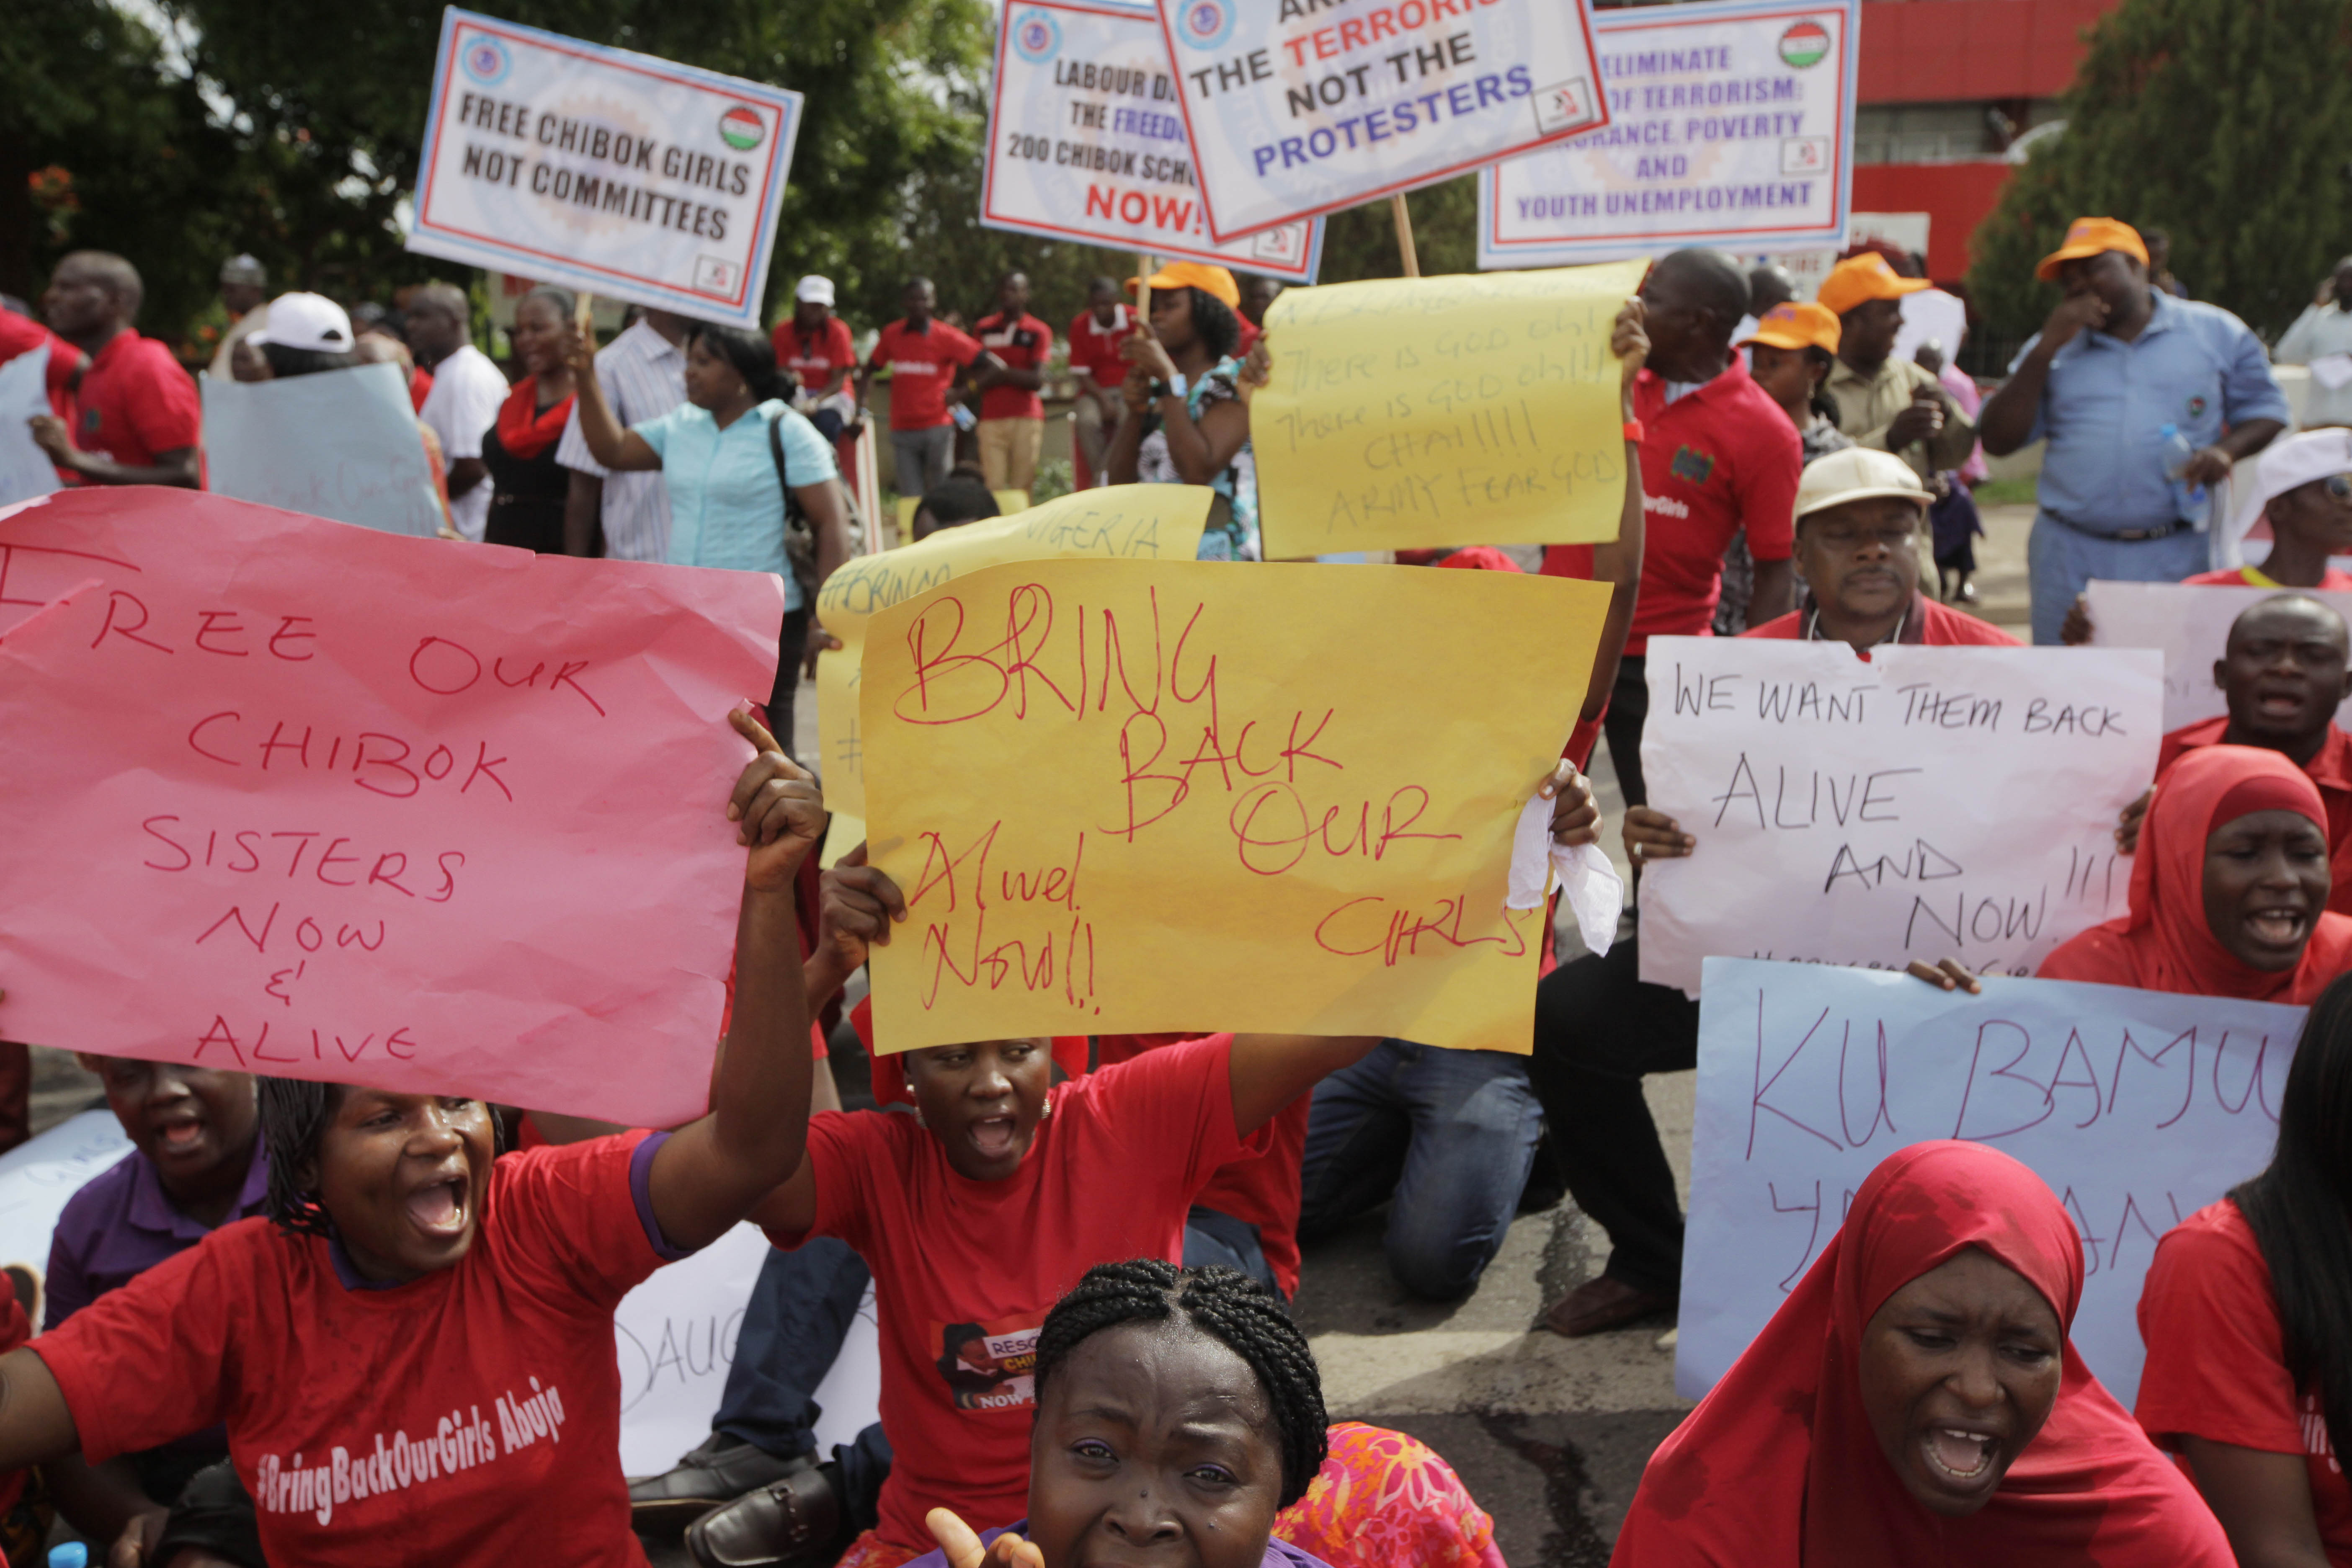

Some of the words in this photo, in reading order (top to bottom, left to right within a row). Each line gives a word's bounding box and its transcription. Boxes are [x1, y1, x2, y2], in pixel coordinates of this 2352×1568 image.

[1055, 59, 1146, 96] LABOUR
[1189, 49, 1274, 99] THE
[1286, 64, 1371, 118] NOT
[1385, 31, 1477, 83] THE
[459, 92, 528, 141] FREE
[537, 112, 657, 170] CHIBOK
[663, 147, 750, 198] GIRLS
[1071, 101, 1107, 129] THE
[1252, 64, 1533, 178] PROTESTERS
[1686, 111, 1805, 142] POVERTY
[461, 145, 525, 188] NOT
[532, 162, 729, 241] COMMITTEES
[1008, 132, 1050, 162] 200
[1056, 140, 1136, 177] CHIBOK
[1636, 155, 1689, 181] AND
[1517, 194, 1596, 220] YOUTH
[1607, 182, 1814, 214] UNEMPLOYMENT
[1435, 328, 1511, 360] GOD
[1427, 374, 1504, 414] GOD
[1326, 472, 1443, 535] ARMY
[1550, 448, 1620, 496] GOD
[893, 581, 1218, 750] BRING
[1675, 662, 1743, 717] WE
[1759, 680, 1880, 723] WANT
[2024, 698, 2127, 737] BACK
[188, 711, 513, 803] CHIBOK
[1096, 708, 1344, 843] BACK
[1711, 751, 1924, 830] ALIVE
[142, 813, 467, 903] SISTERS
[1229, 780, 1462, 875] OUR
[1824, 838, 1963, 894] AND
[192, 1014, 419, 1068] ALIVE
[1746, 987, 1897, 1160] KU
[979, 1394, 1023, 1408] NOW
[256, 1404, 496, 1526] #BringBackOurGirls
[495, 1375, 566, 1455] Abuja
